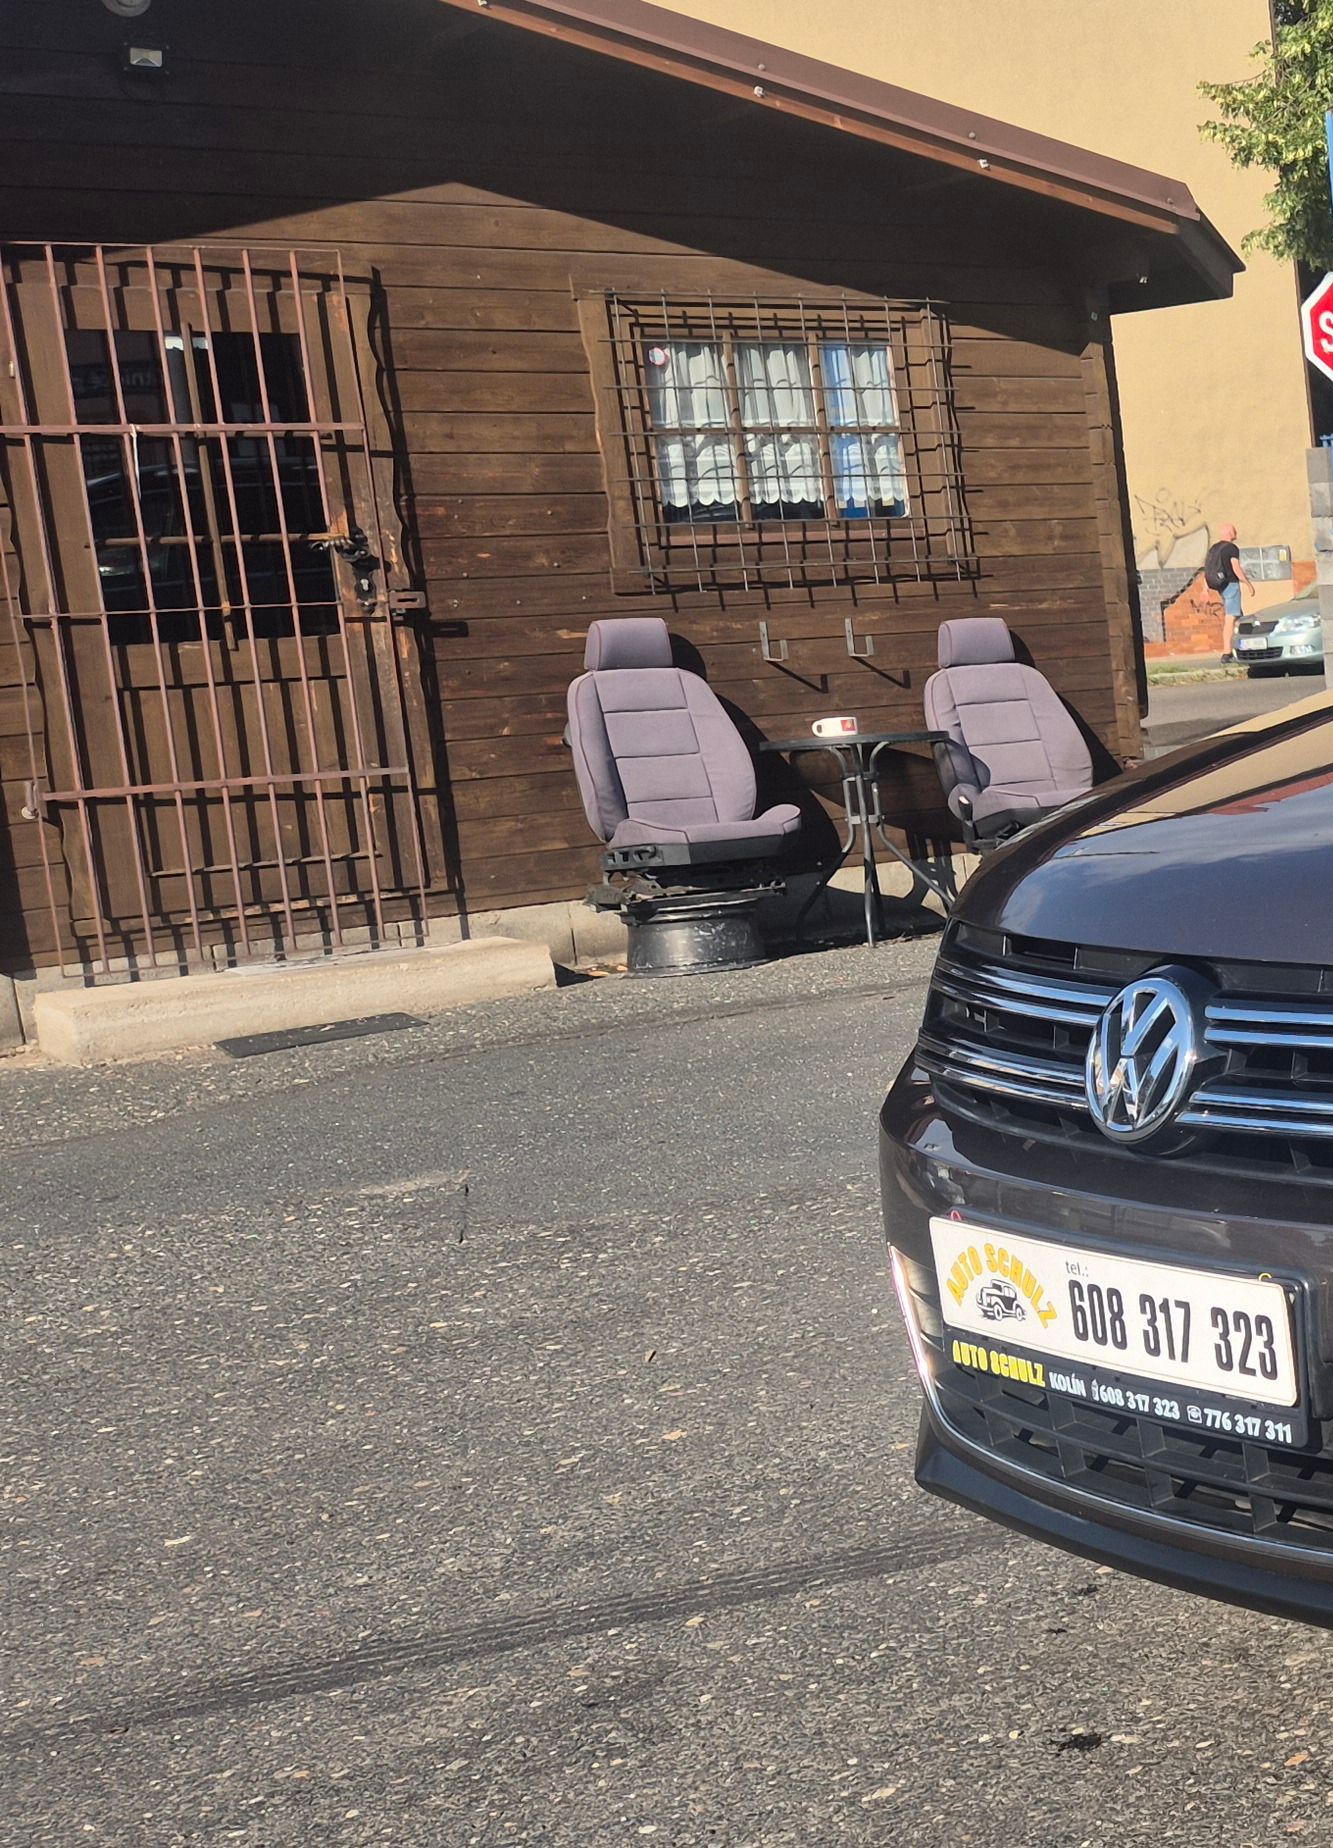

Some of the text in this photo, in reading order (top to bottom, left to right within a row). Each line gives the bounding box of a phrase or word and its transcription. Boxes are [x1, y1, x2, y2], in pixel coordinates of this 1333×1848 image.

[946, 1243, 1058, 1329] AUTO SCHULZ
[1064, 1260, 1089, 1278] tel.:
[1068, 1279, 1278, 1380] 608 317 323
[952, 1340, 1293, 1444] AUTO SCHULZ KOLÍN 608 317 323 776 317 311
